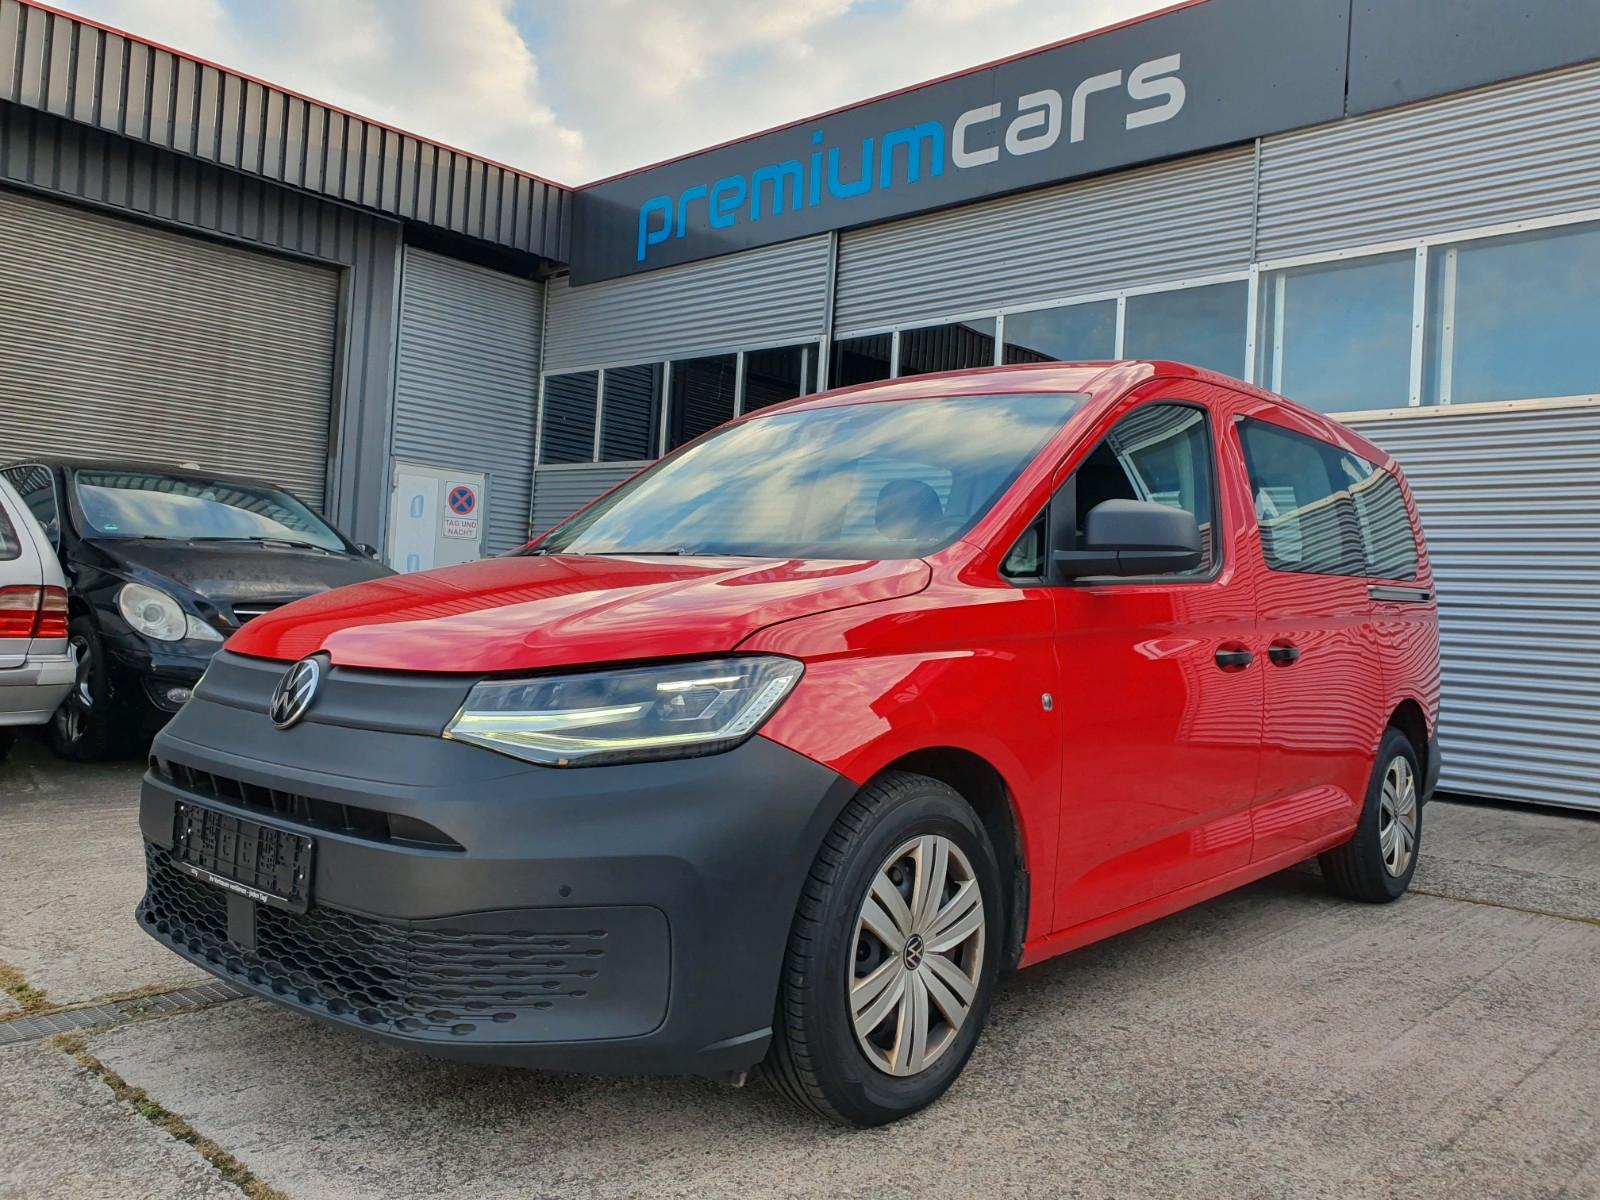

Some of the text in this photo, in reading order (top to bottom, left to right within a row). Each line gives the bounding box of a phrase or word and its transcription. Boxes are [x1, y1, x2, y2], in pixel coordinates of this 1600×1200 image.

[637, 53, 1186, 262] premiumcars
[446, 519, 477, 529] TAG UND
[448, 528, 473, 536] NACHT
